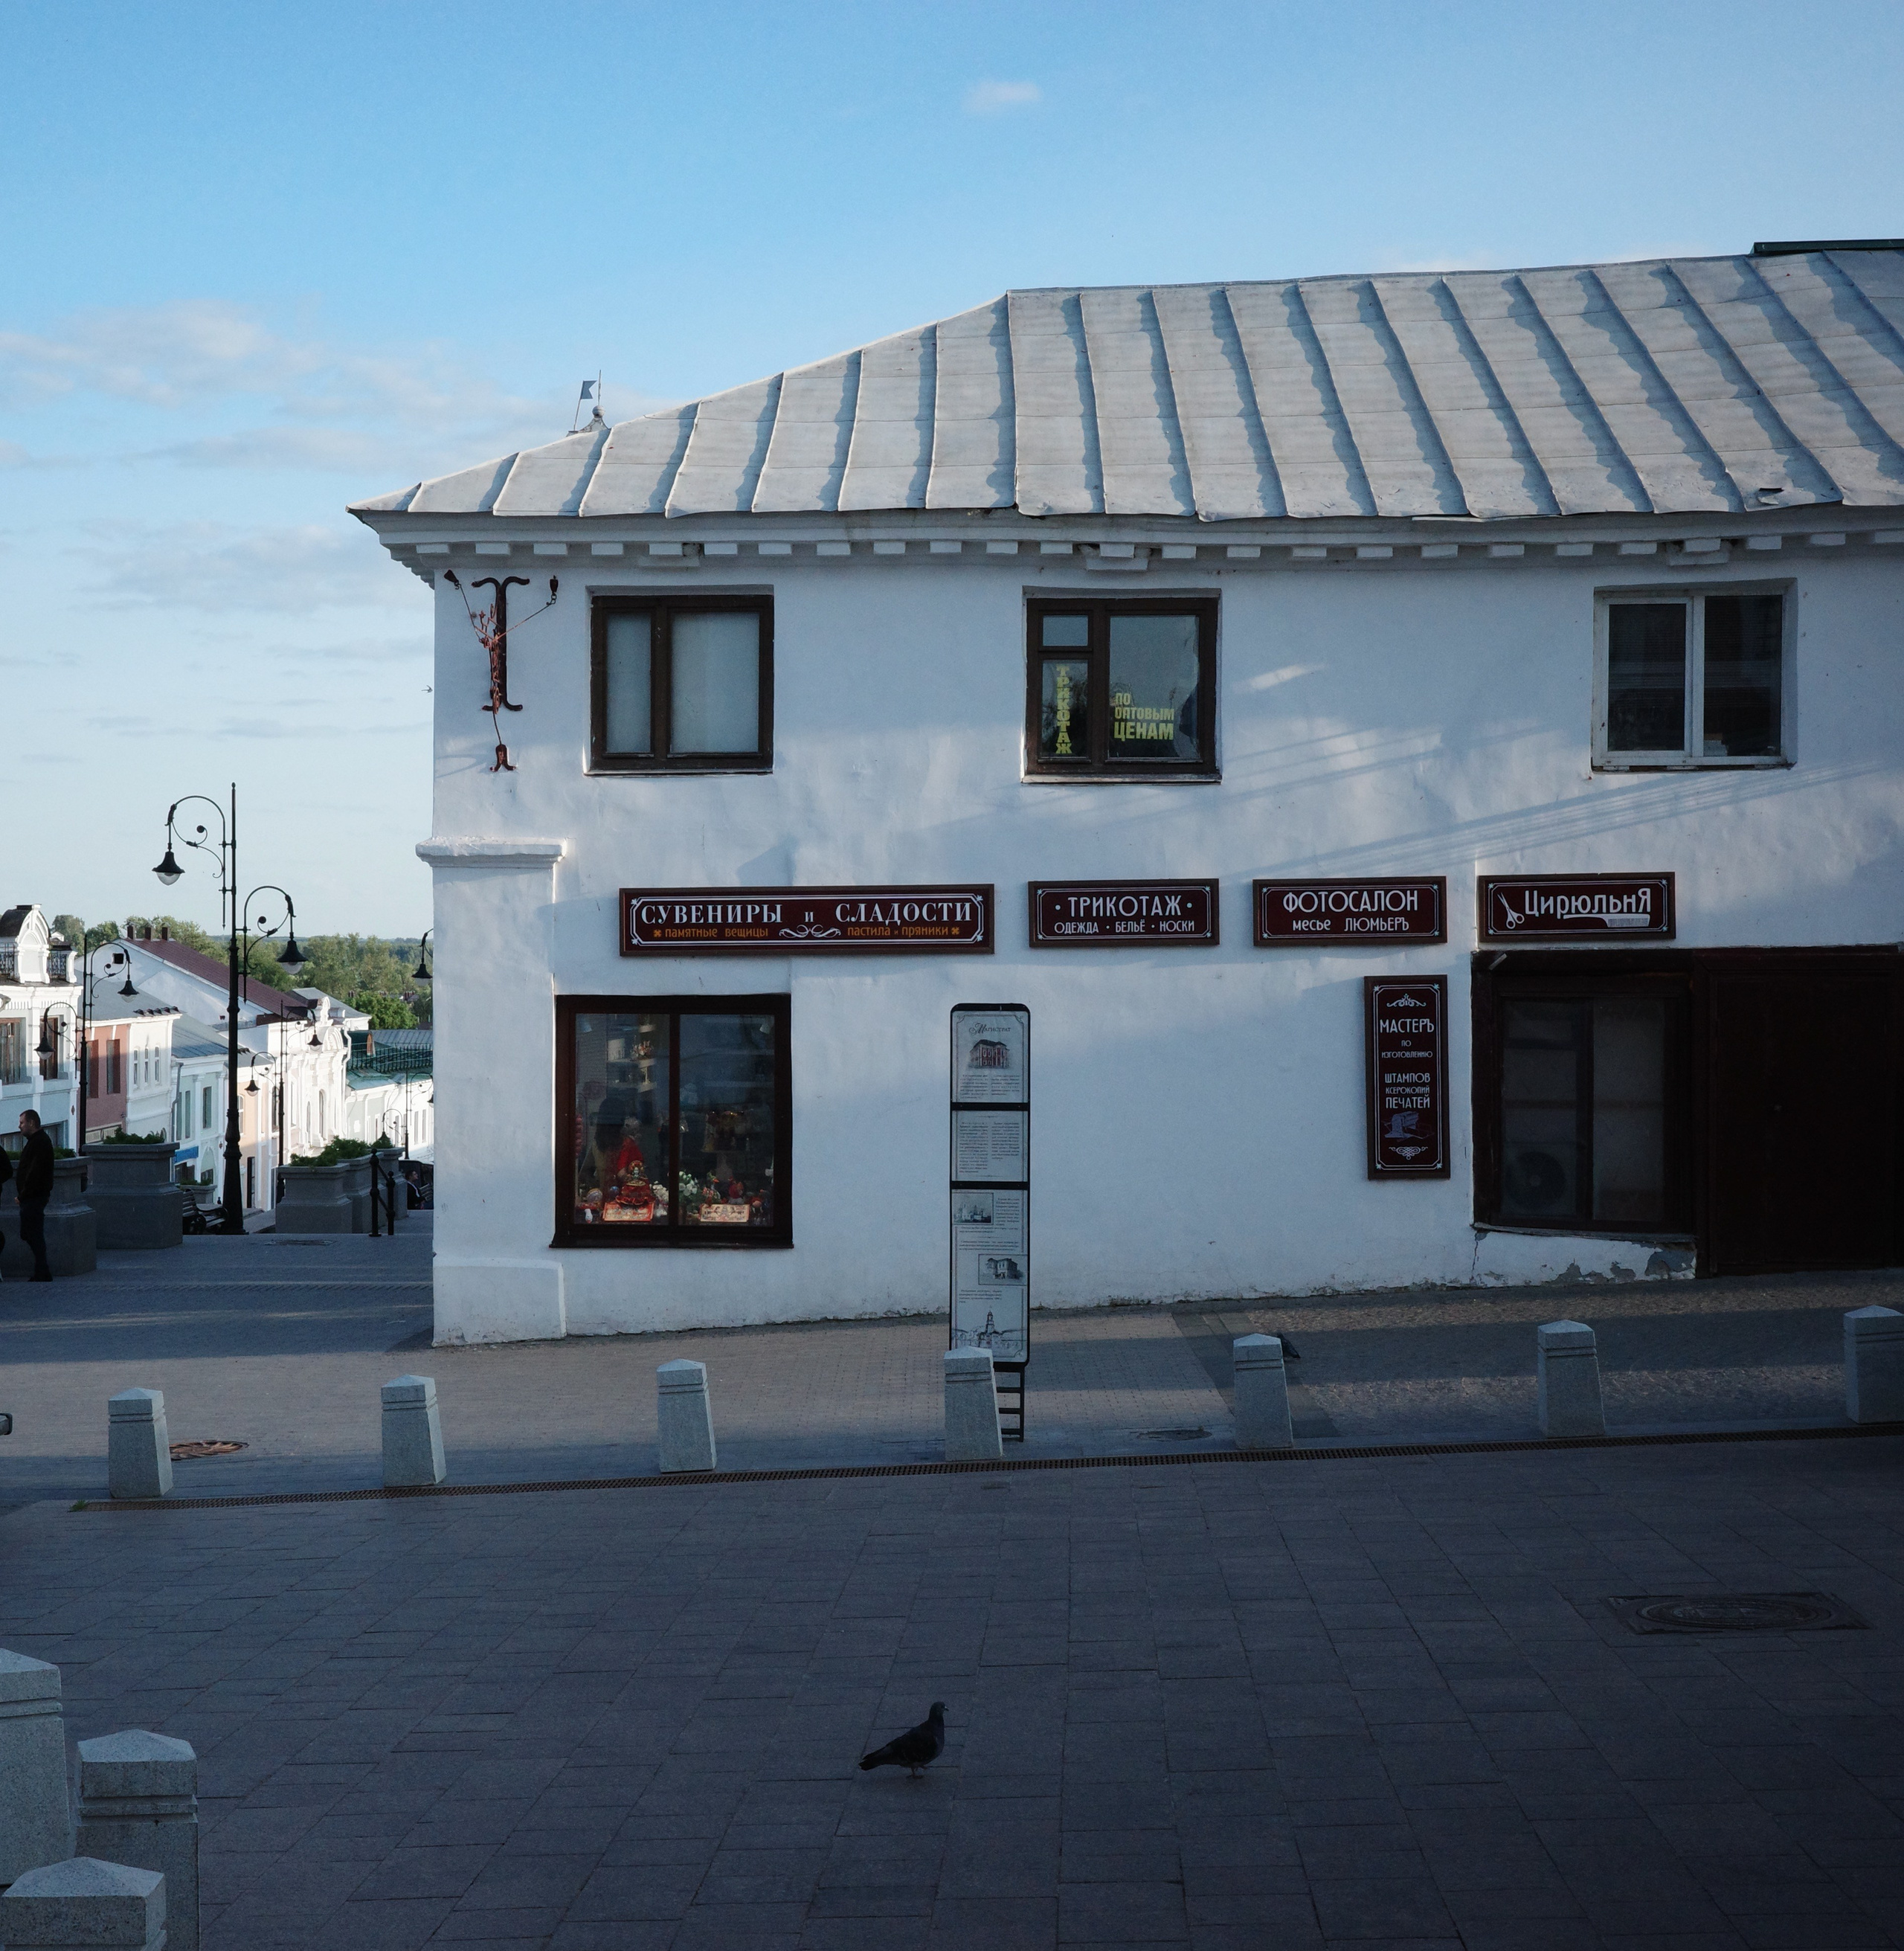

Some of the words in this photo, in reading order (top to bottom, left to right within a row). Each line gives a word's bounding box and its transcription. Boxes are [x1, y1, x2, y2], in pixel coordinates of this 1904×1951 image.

[1116, 692, 1131, 705] ПО
[1055, 664, 1072, 754] ТРИКОТАЖ
[1115, 707, 1174, 721] ОПТОВЫМ
[1114, 721, 1174, 742] ЦЕНАМ
[1067, 896, 1182, 917] ТРИКОТАЖ
[1283, 890, 1418, 913] ФОТОСАЛОН
[641, 904, 783, 925] СУВЕНИРЫ
[835, 902, 972, 926] СЛАДОСТИ
[847, 926, 891, 936] пастила
[901, 925, 948, 937] пряники
[1054, 922, 1099, 934] ОДЕЖДА
[1115, 919, 1146, 933] БЕЛЬЁ
[1160, 920, 1195, 932] НОСКИ
[1293, 919, 1331, 931] месье
[1344, 916, 1409, 932] ЛЮМЬЕРЪ
[665, 928, 718, 938] памятные
[724, 928, 768, 938] вещицы
[1380, 1018, 1435, 1033] МАСТЕРЪ
[1381, 1050, 1433, 1058] ИЗГОТОВЛЕНИЮ
[1385, 1073, 1431, 1084] ШТАМПОВ
[1386, 1085, 1430, 1095] КСЕРОКОПИЙ
[1386, 1094, 1430, 1109] ПЕЧАТЕЙ
